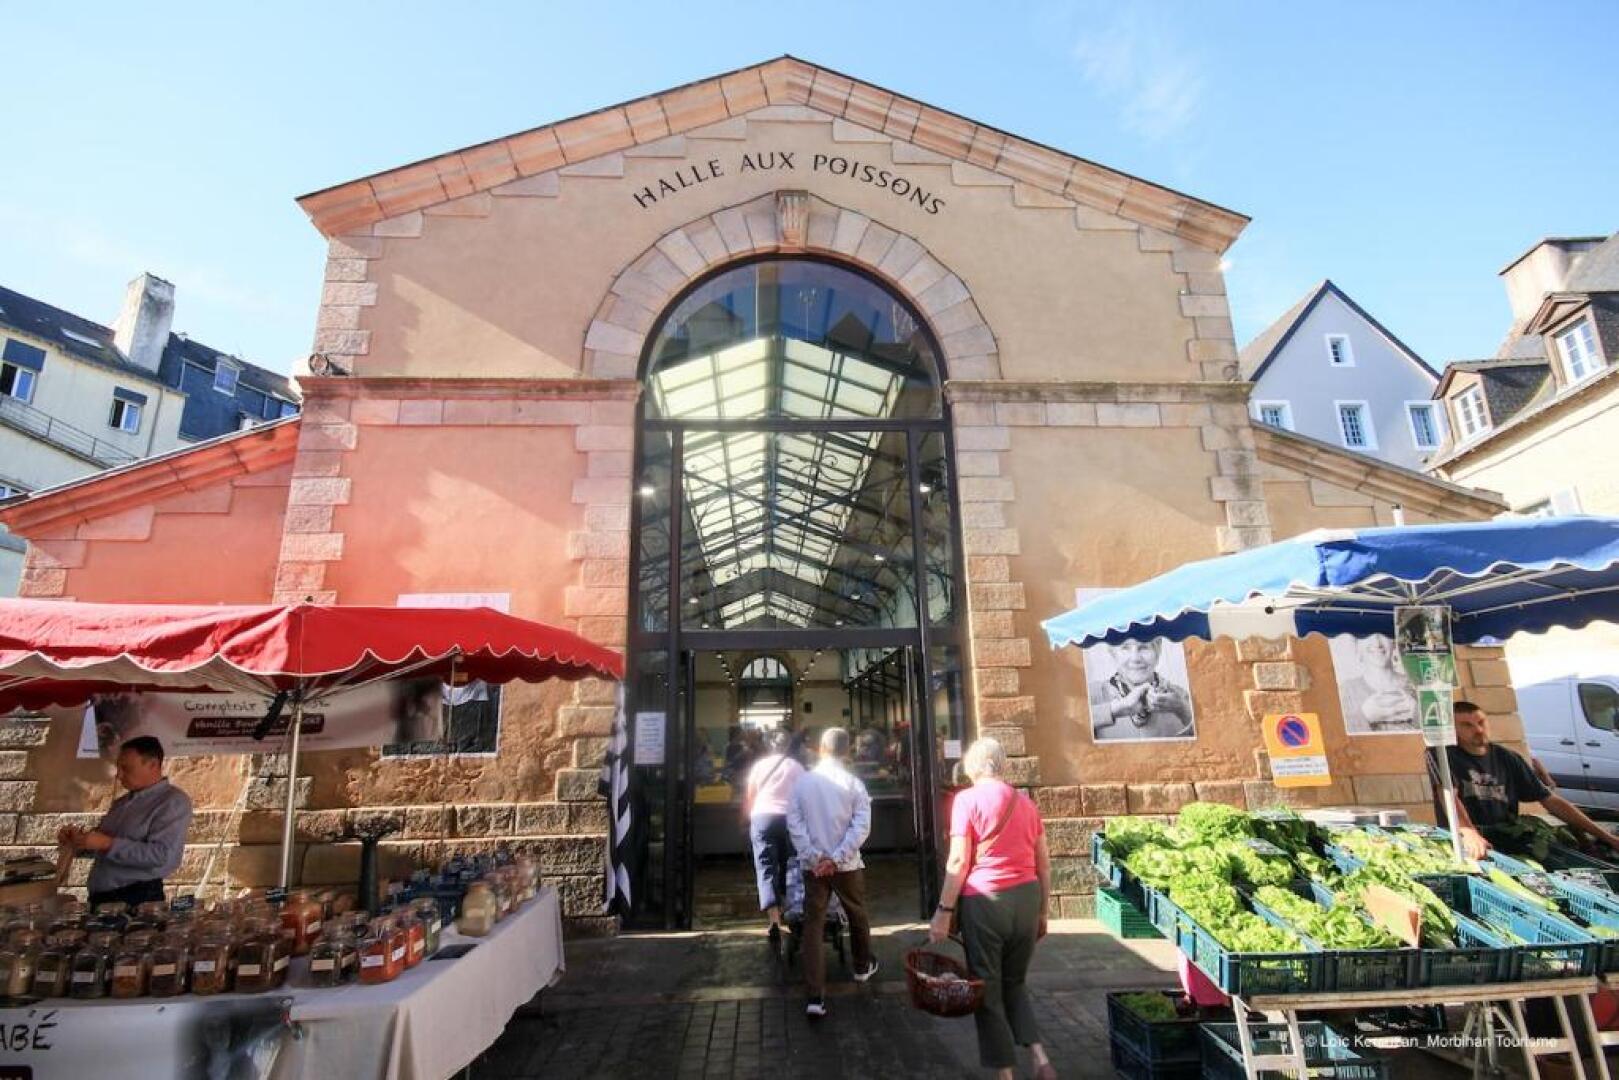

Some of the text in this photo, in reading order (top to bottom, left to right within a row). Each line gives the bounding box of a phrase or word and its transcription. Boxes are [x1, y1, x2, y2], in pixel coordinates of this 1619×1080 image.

[633, 151, 946, 214] HALLE AUX POISSONS
